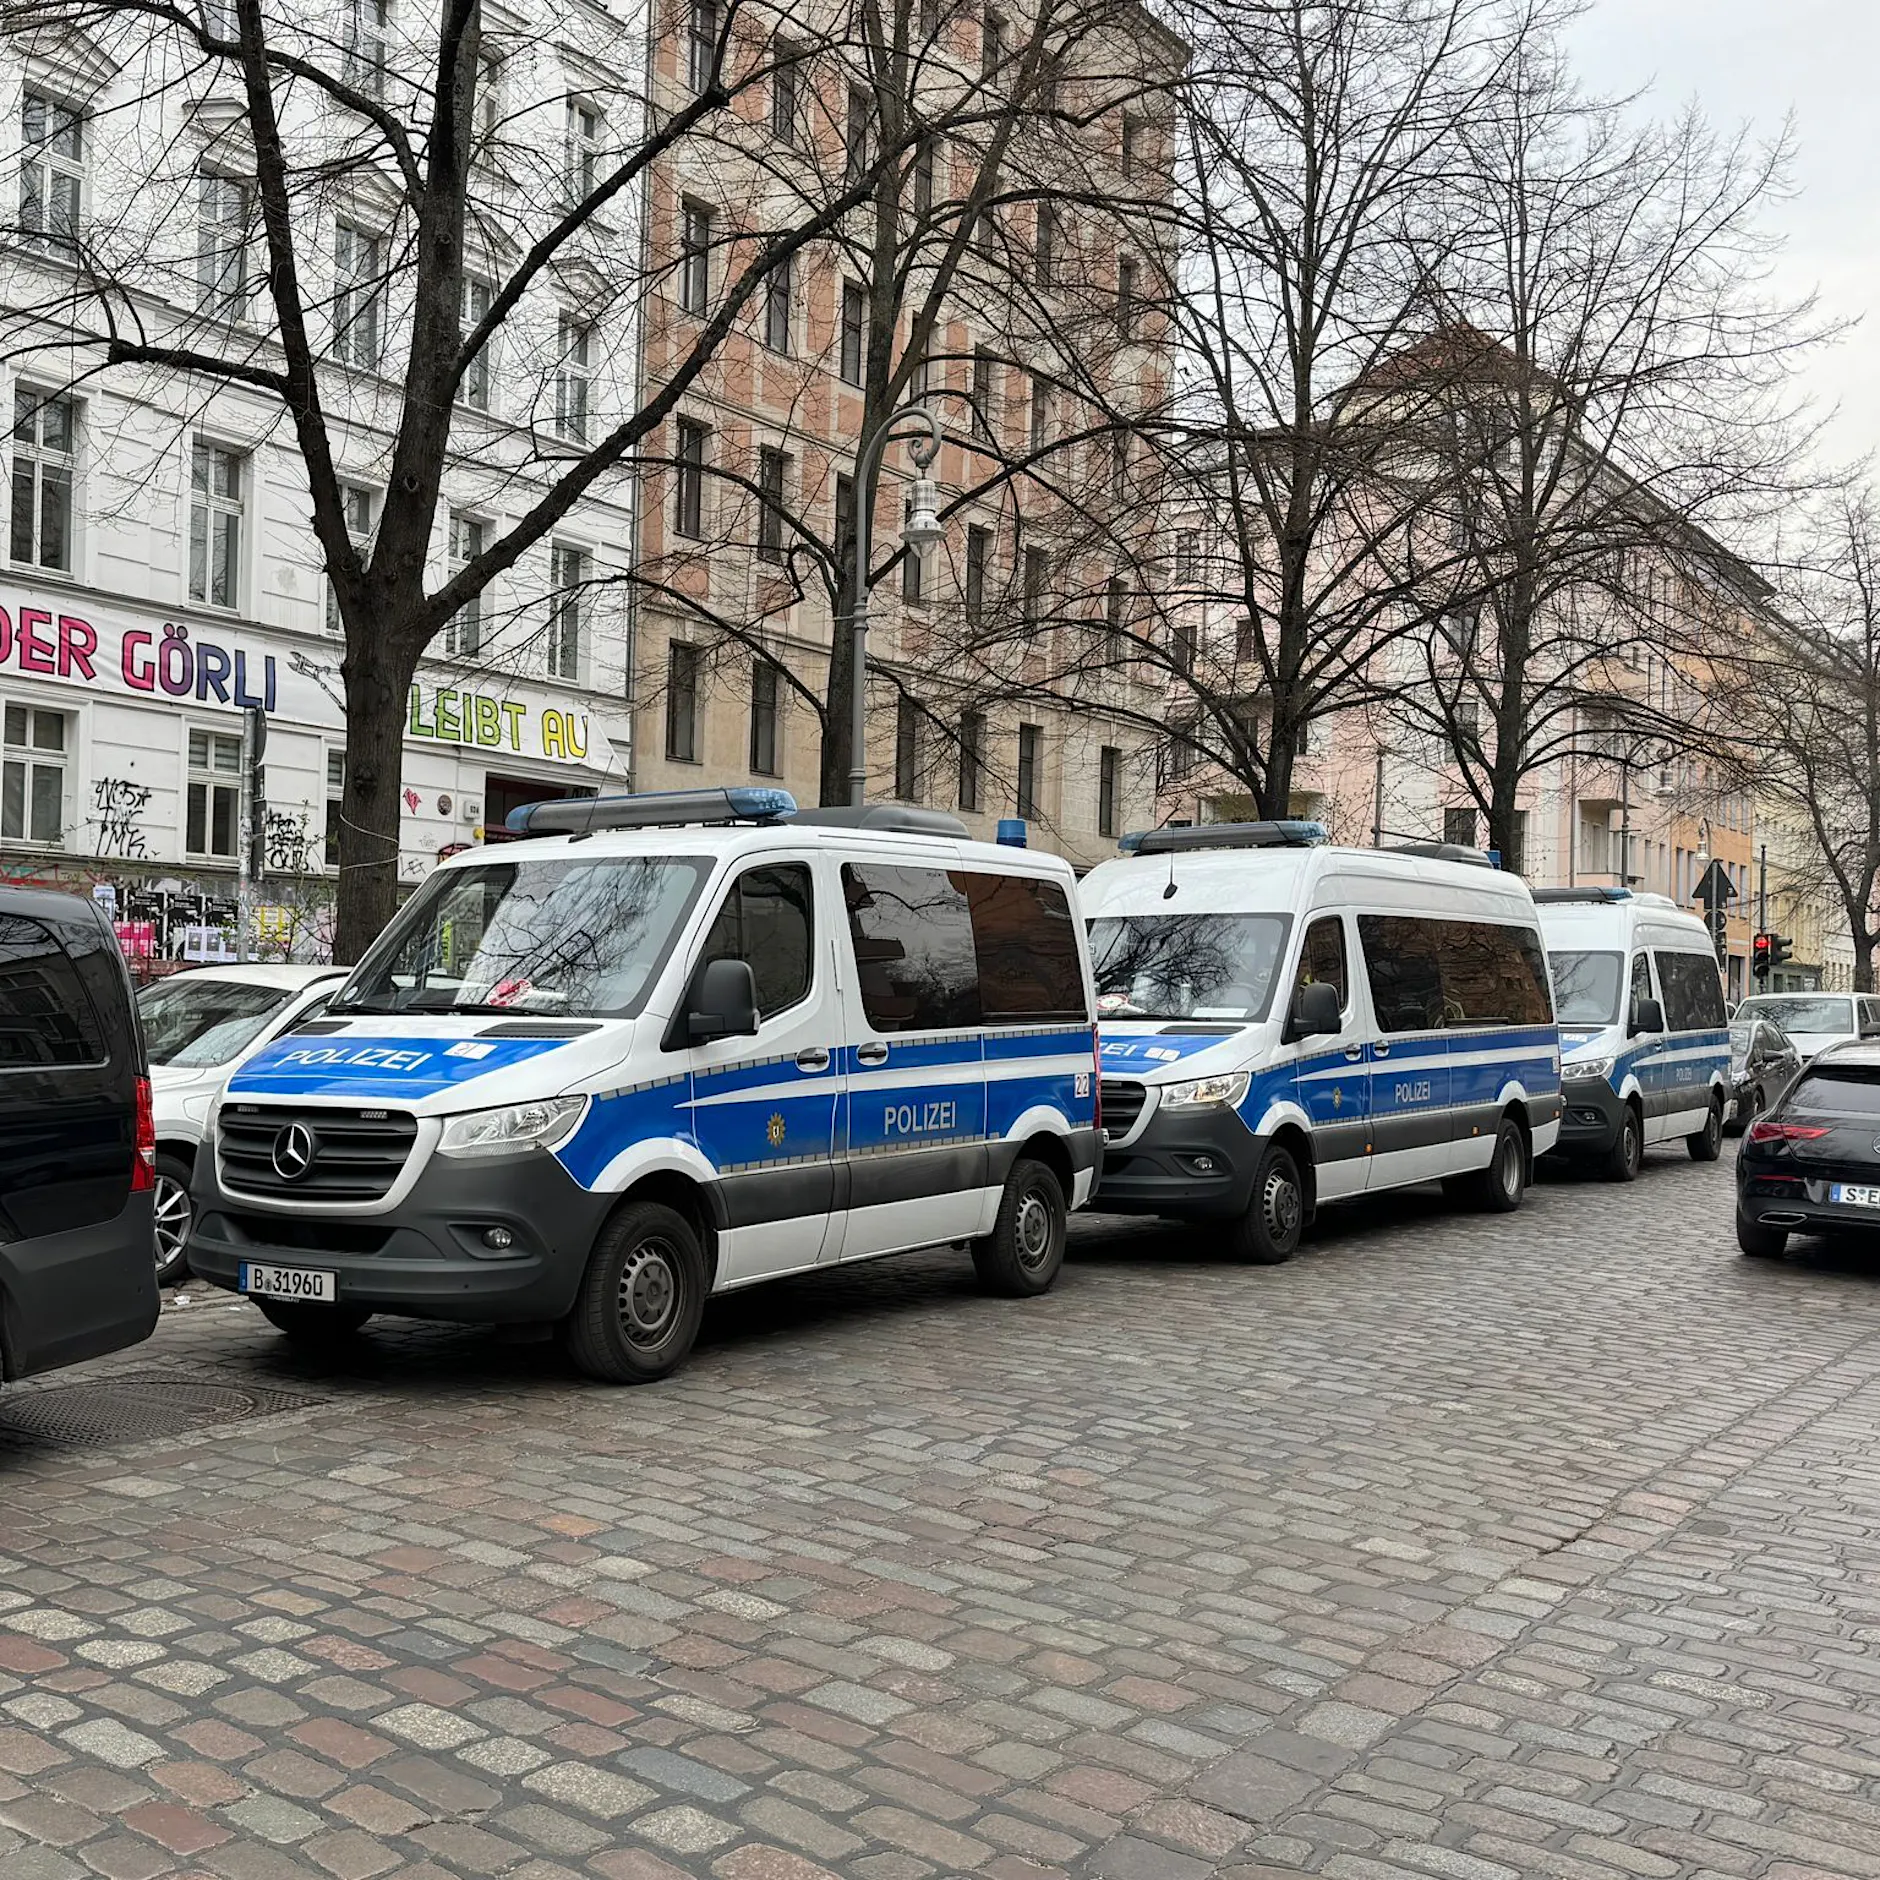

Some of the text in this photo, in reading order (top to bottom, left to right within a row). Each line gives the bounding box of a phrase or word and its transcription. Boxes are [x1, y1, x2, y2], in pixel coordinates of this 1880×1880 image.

[121, 623, 276, 712] GÖRLI
[409, 682, 526, 751] LEIBT
[541, 708, 589, 759] AU
[272, 1047, 433, 1072] POLIZEI
[1076, 1075, 1088, 1096] 22
[1395, 1080, 1430, 1104] POLIZEI
[884, 1101, 956, 1136] POLIZEI
[1846, 1187, 1880, 1205] S E
[254, 1268, 323, 1297] B 31960
